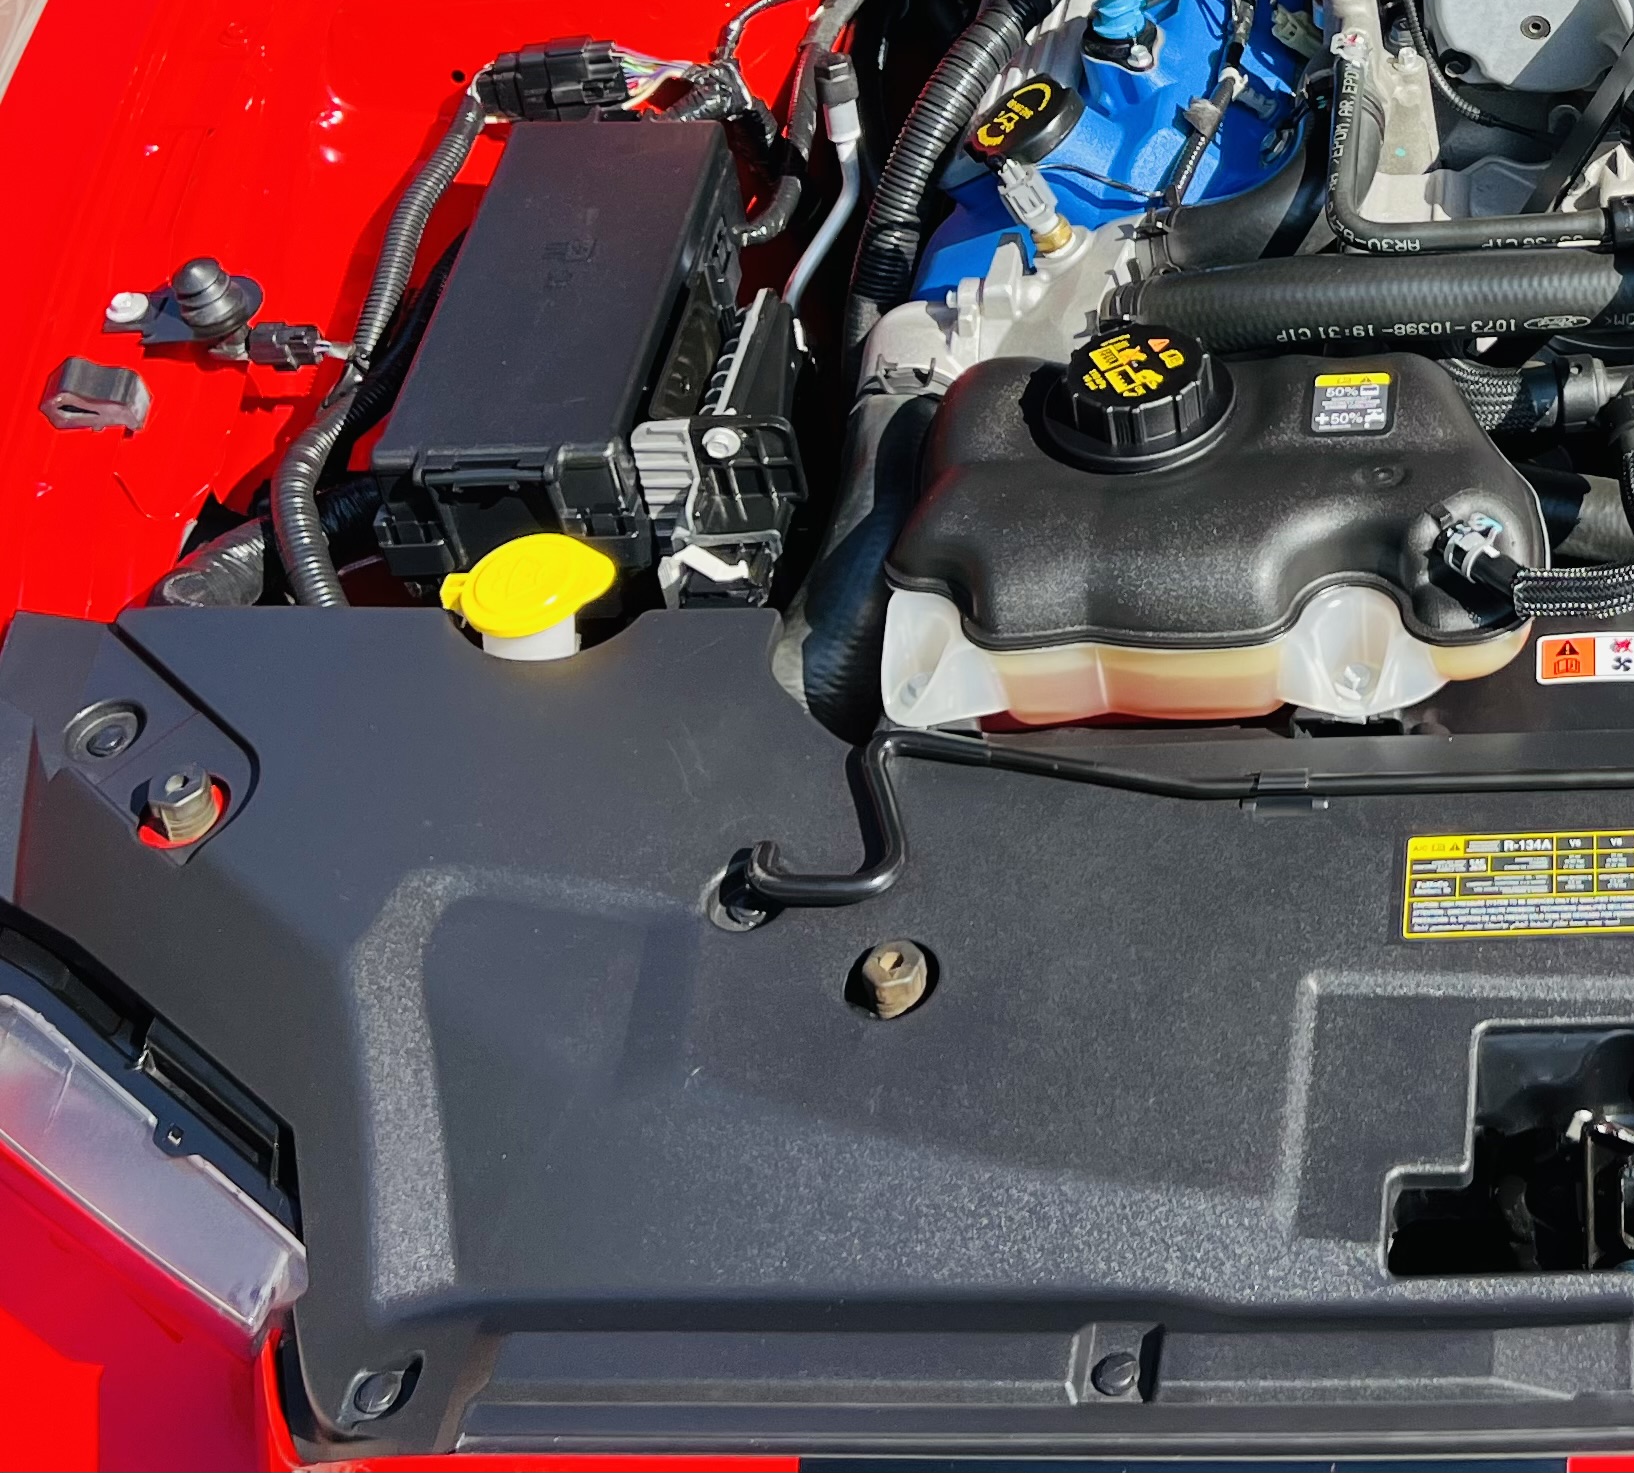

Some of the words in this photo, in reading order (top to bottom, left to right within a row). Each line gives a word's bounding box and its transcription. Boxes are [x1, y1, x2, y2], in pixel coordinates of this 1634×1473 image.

[1318, 325, 1374, 340] 19:31
[1325, 386, 1359, 398] 50%
[1503, 838, 1552, 852] R-134A
